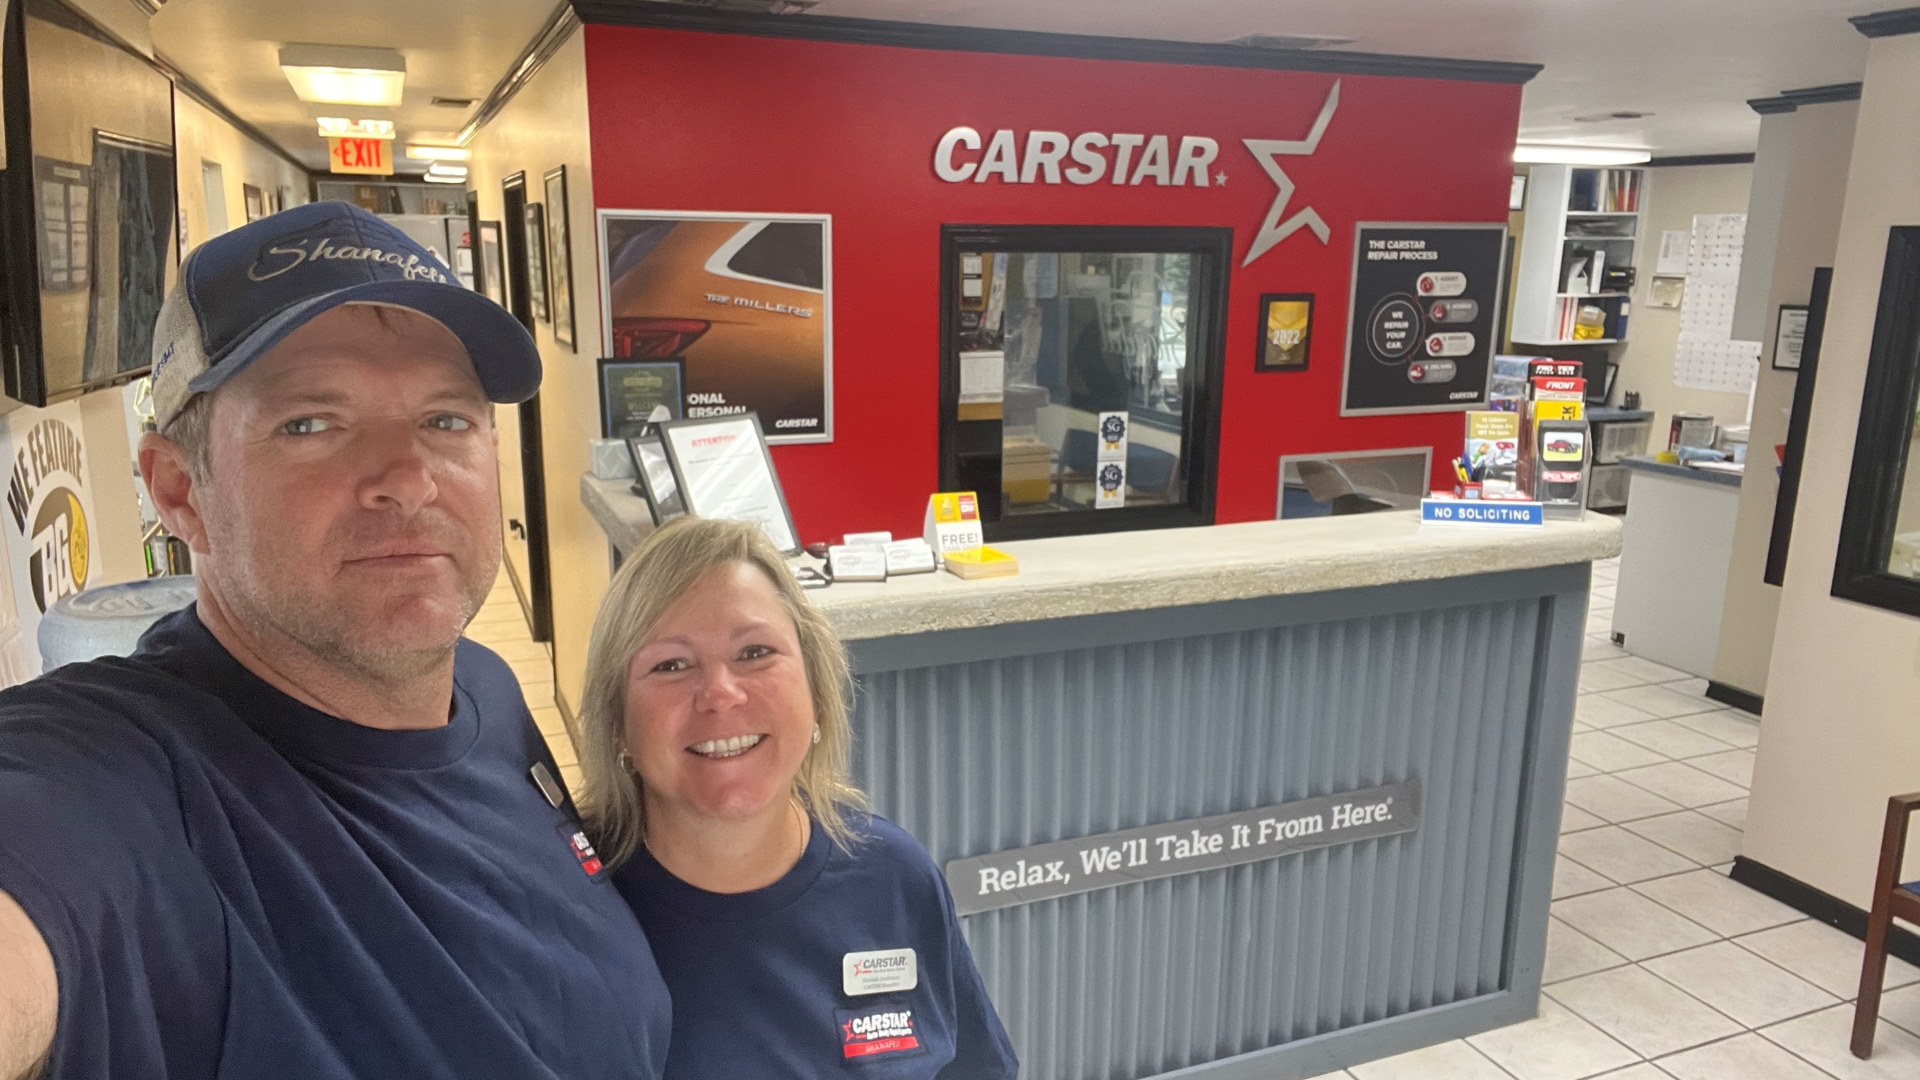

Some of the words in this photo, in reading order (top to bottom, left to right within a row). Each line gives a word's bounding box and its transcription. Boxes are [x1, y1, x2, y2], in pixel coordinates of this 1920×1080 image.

[340, 138, 382, 168] EXIT
[934, 126, 1219, 187] CARSTAR
[1369, 240, 1385, 249] THE
[1387, 240, 1426, 249] CARSTAR
[1367, 251, 1399, 260] REPAIR
[1400, 251, 1438, 260] PROCESS
[734, 297, 813, 318] MILLERS
[1273, 329, 1300, 344] 2022
[1546, 381, 1575, 389] FRONT
[775, 418, 818, 429] CARSTAR
[7, 446, 34, 537] WE
[28, 419, 82, 487] FEATURE
[1434, 507, 1453, 519] NO
[1458, 507, 1530, 521] SOLICITING
[941, 532, 979, 545] FREE!
[31, 512, 78, 608] BG
[978, 861, 1071, 896] Relax,
[1078, 838, 1149, 876] We'll
[1155, 830, 1223, 862] Take
[1230, 824, 1251, 850] It
[1257, 813, 1323, 845] From
[863, 956, 906, 969] CARSTAR
[853, 1012, 909, 1034] CARSTAR
